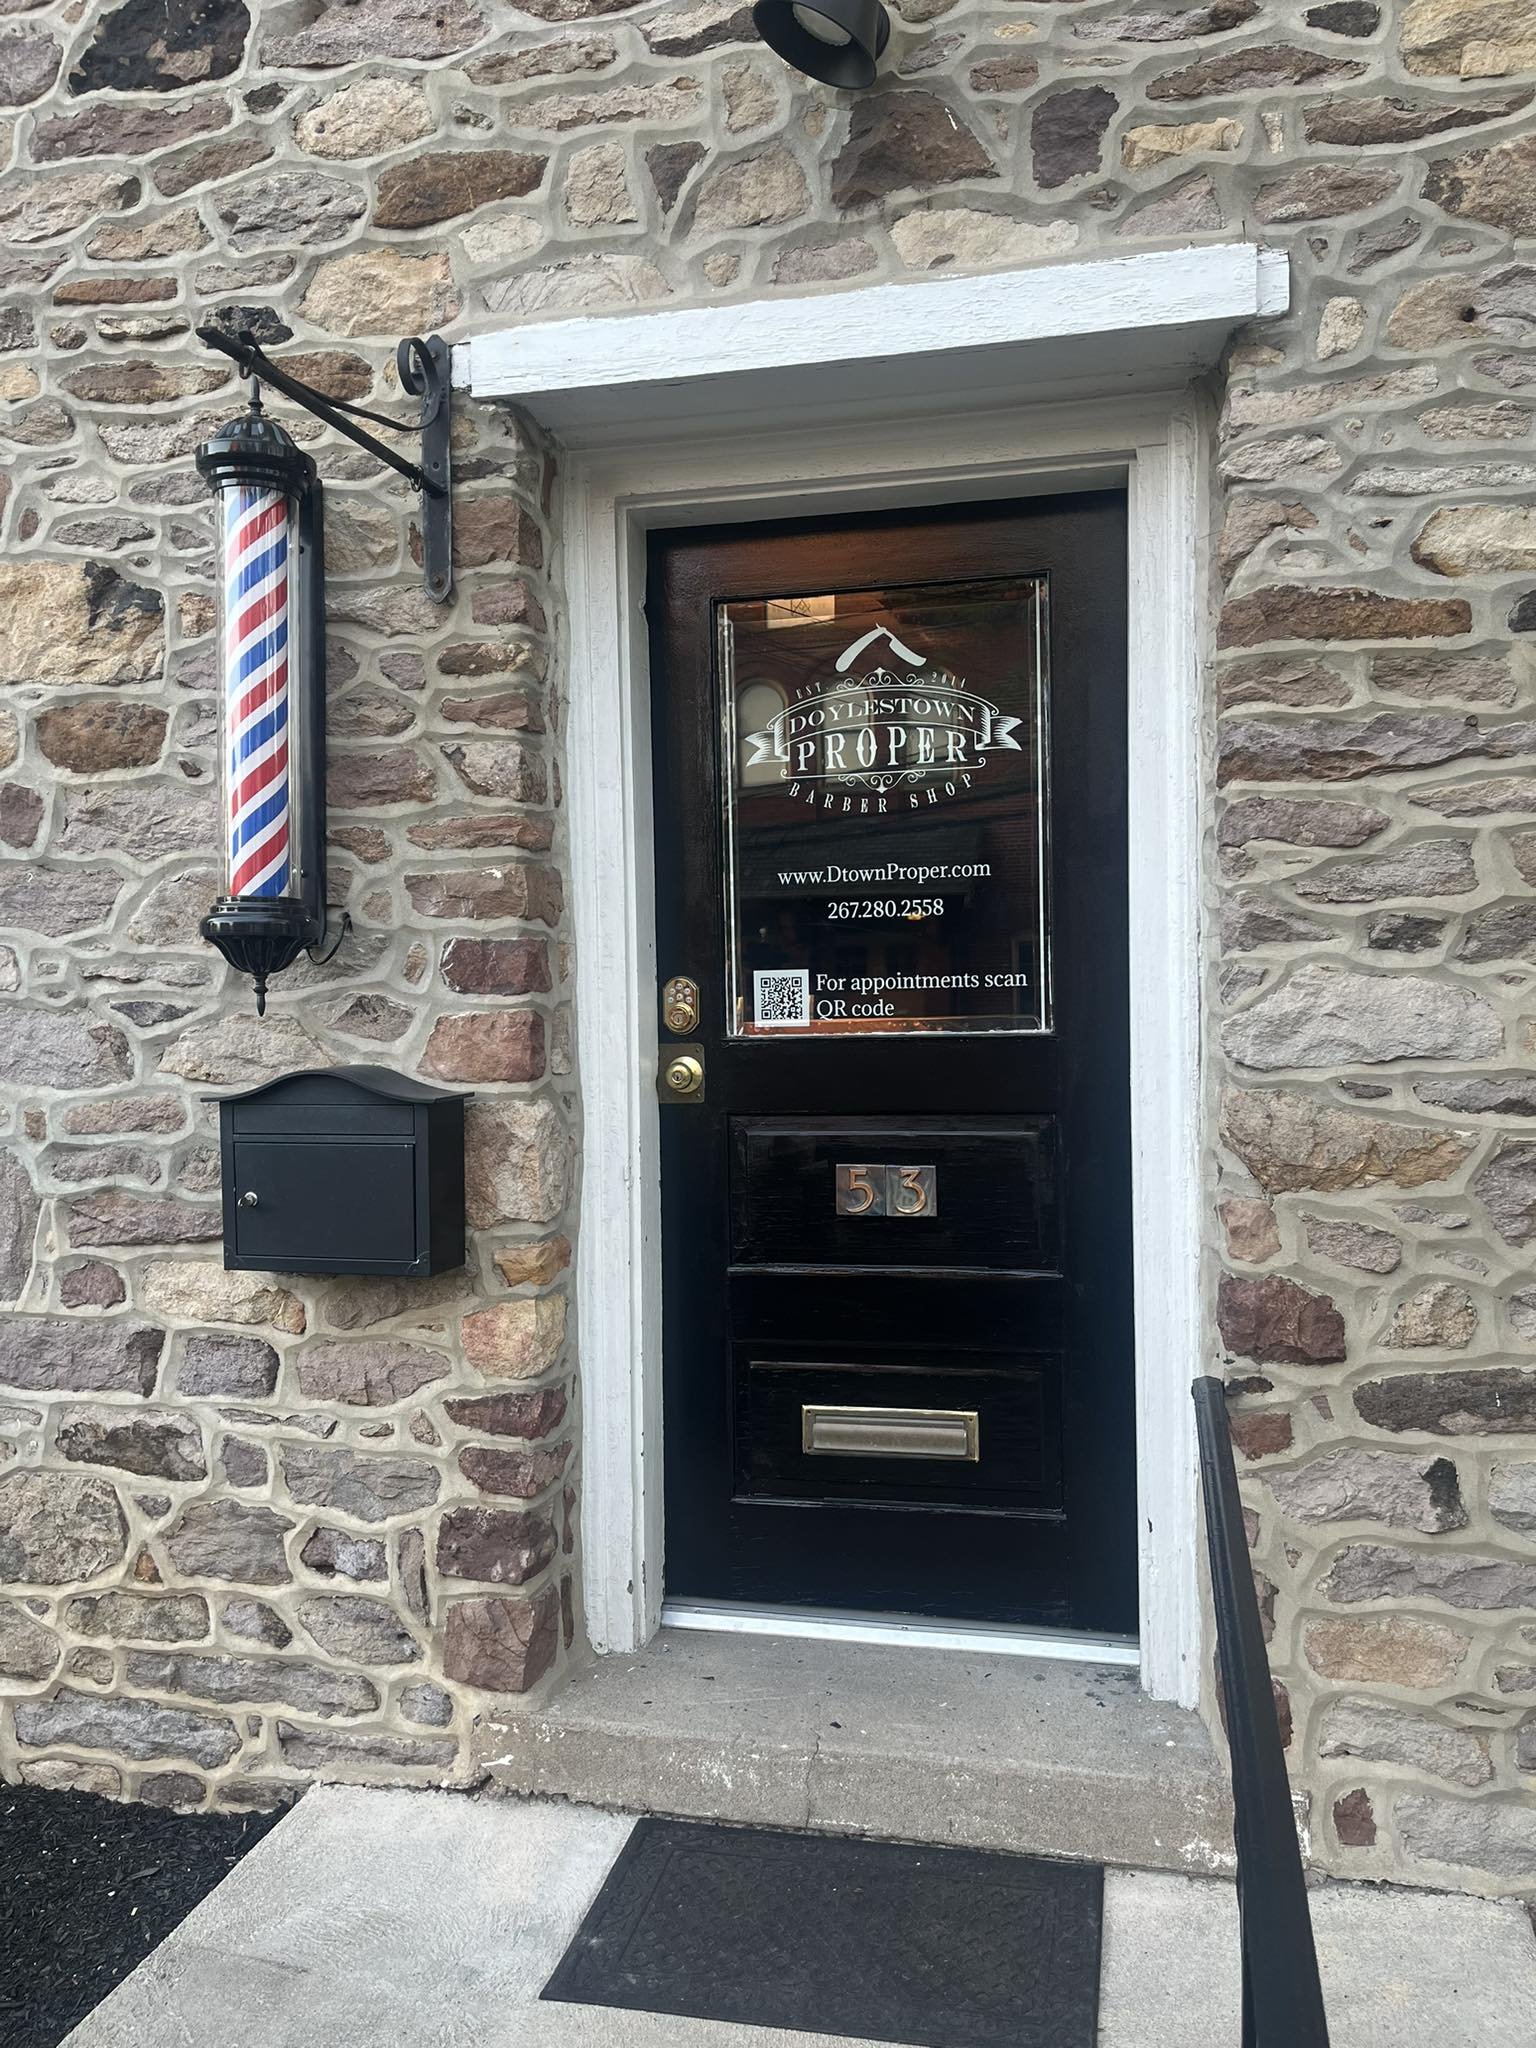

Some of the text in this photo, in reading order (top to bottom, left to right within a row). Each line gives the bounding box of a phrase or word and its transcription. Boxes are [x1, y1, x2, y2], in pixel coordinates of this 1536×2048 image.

[789, 697, 976, 735] DOYLESTOWN
[796, 725, 968, 772] PROPER
[788, 773, 973, 813] BARBER SHOP
[777, 862, 992, 886] www.DtownProper.com
[827, 898, 945, 919] 267.280.2558
[815, 971, 1028, 995] For appointments scan
[816, 999, 895, 1021] QR code
[845, 1167, 928, 1214] 53
